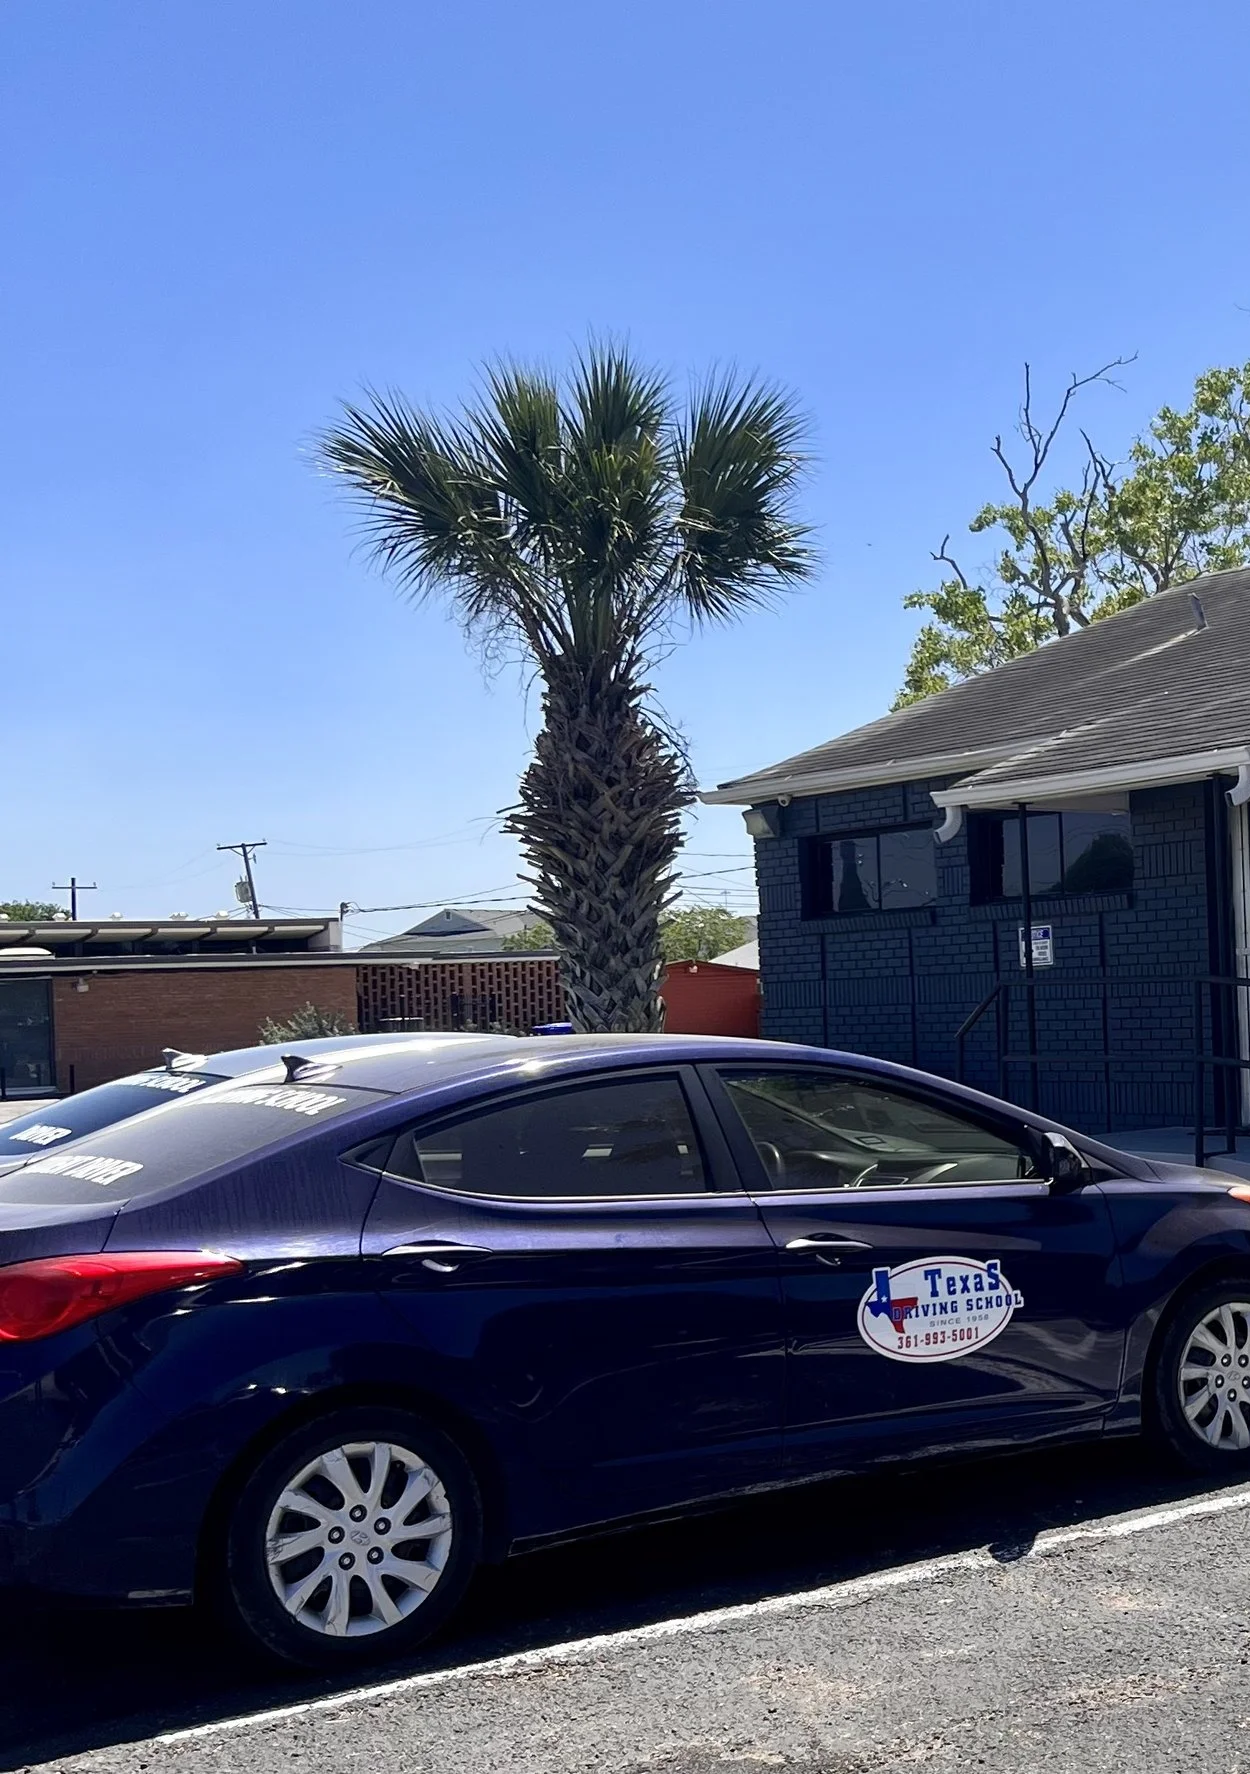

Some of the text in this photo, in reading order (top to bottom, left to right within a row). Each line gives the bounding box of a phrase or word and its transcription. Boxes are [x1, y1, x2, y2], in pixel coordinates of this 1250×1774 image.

[253, 1088, 347, 1116] SCHOOL
[61, 1156, 144, 1187] DRIVER
[892, 1292, 1023, 1322] DRIVING SCHOOL
[929, 1318, 962, 1328] SINCE
[897, 1326, 980, 1350] 361-993-5001
